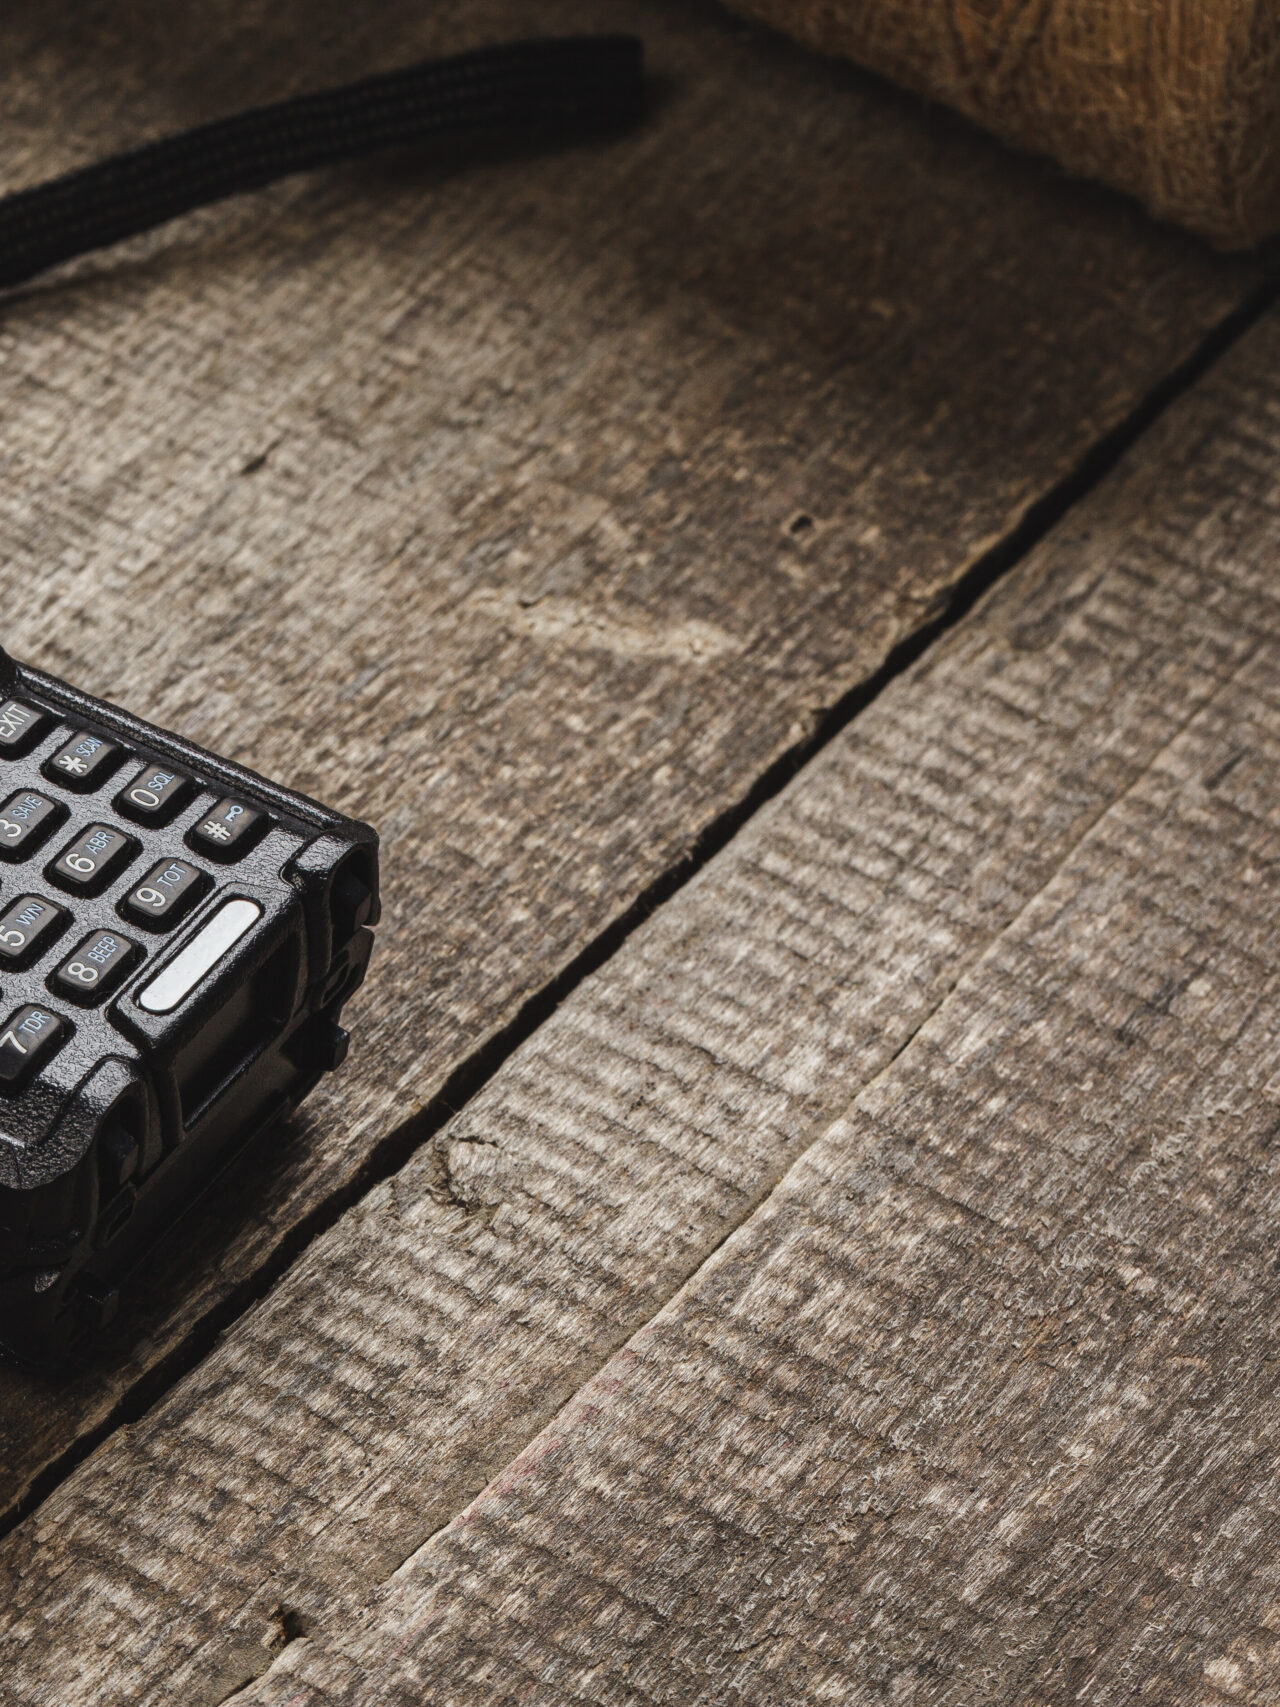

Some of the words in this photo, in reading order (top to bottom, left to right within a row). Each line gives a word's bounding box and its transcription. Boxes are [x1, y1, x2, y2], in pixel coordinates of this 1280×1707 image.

[75, 736, 103, 758] SCAN
[147, 772, 176, 791] SQL
[12, 793, 42, 820] SAVE
[65, 853, 96, 873] 6
[85, 831, 116, 854] ABR
[136, 887, 167, 908] 9
[157, 863, 189, 888] TOT
[67, 962, 100, 983] 8
[87, 935, 119, 964] BEEP
[19, 1010, 52, 1036] TDR
